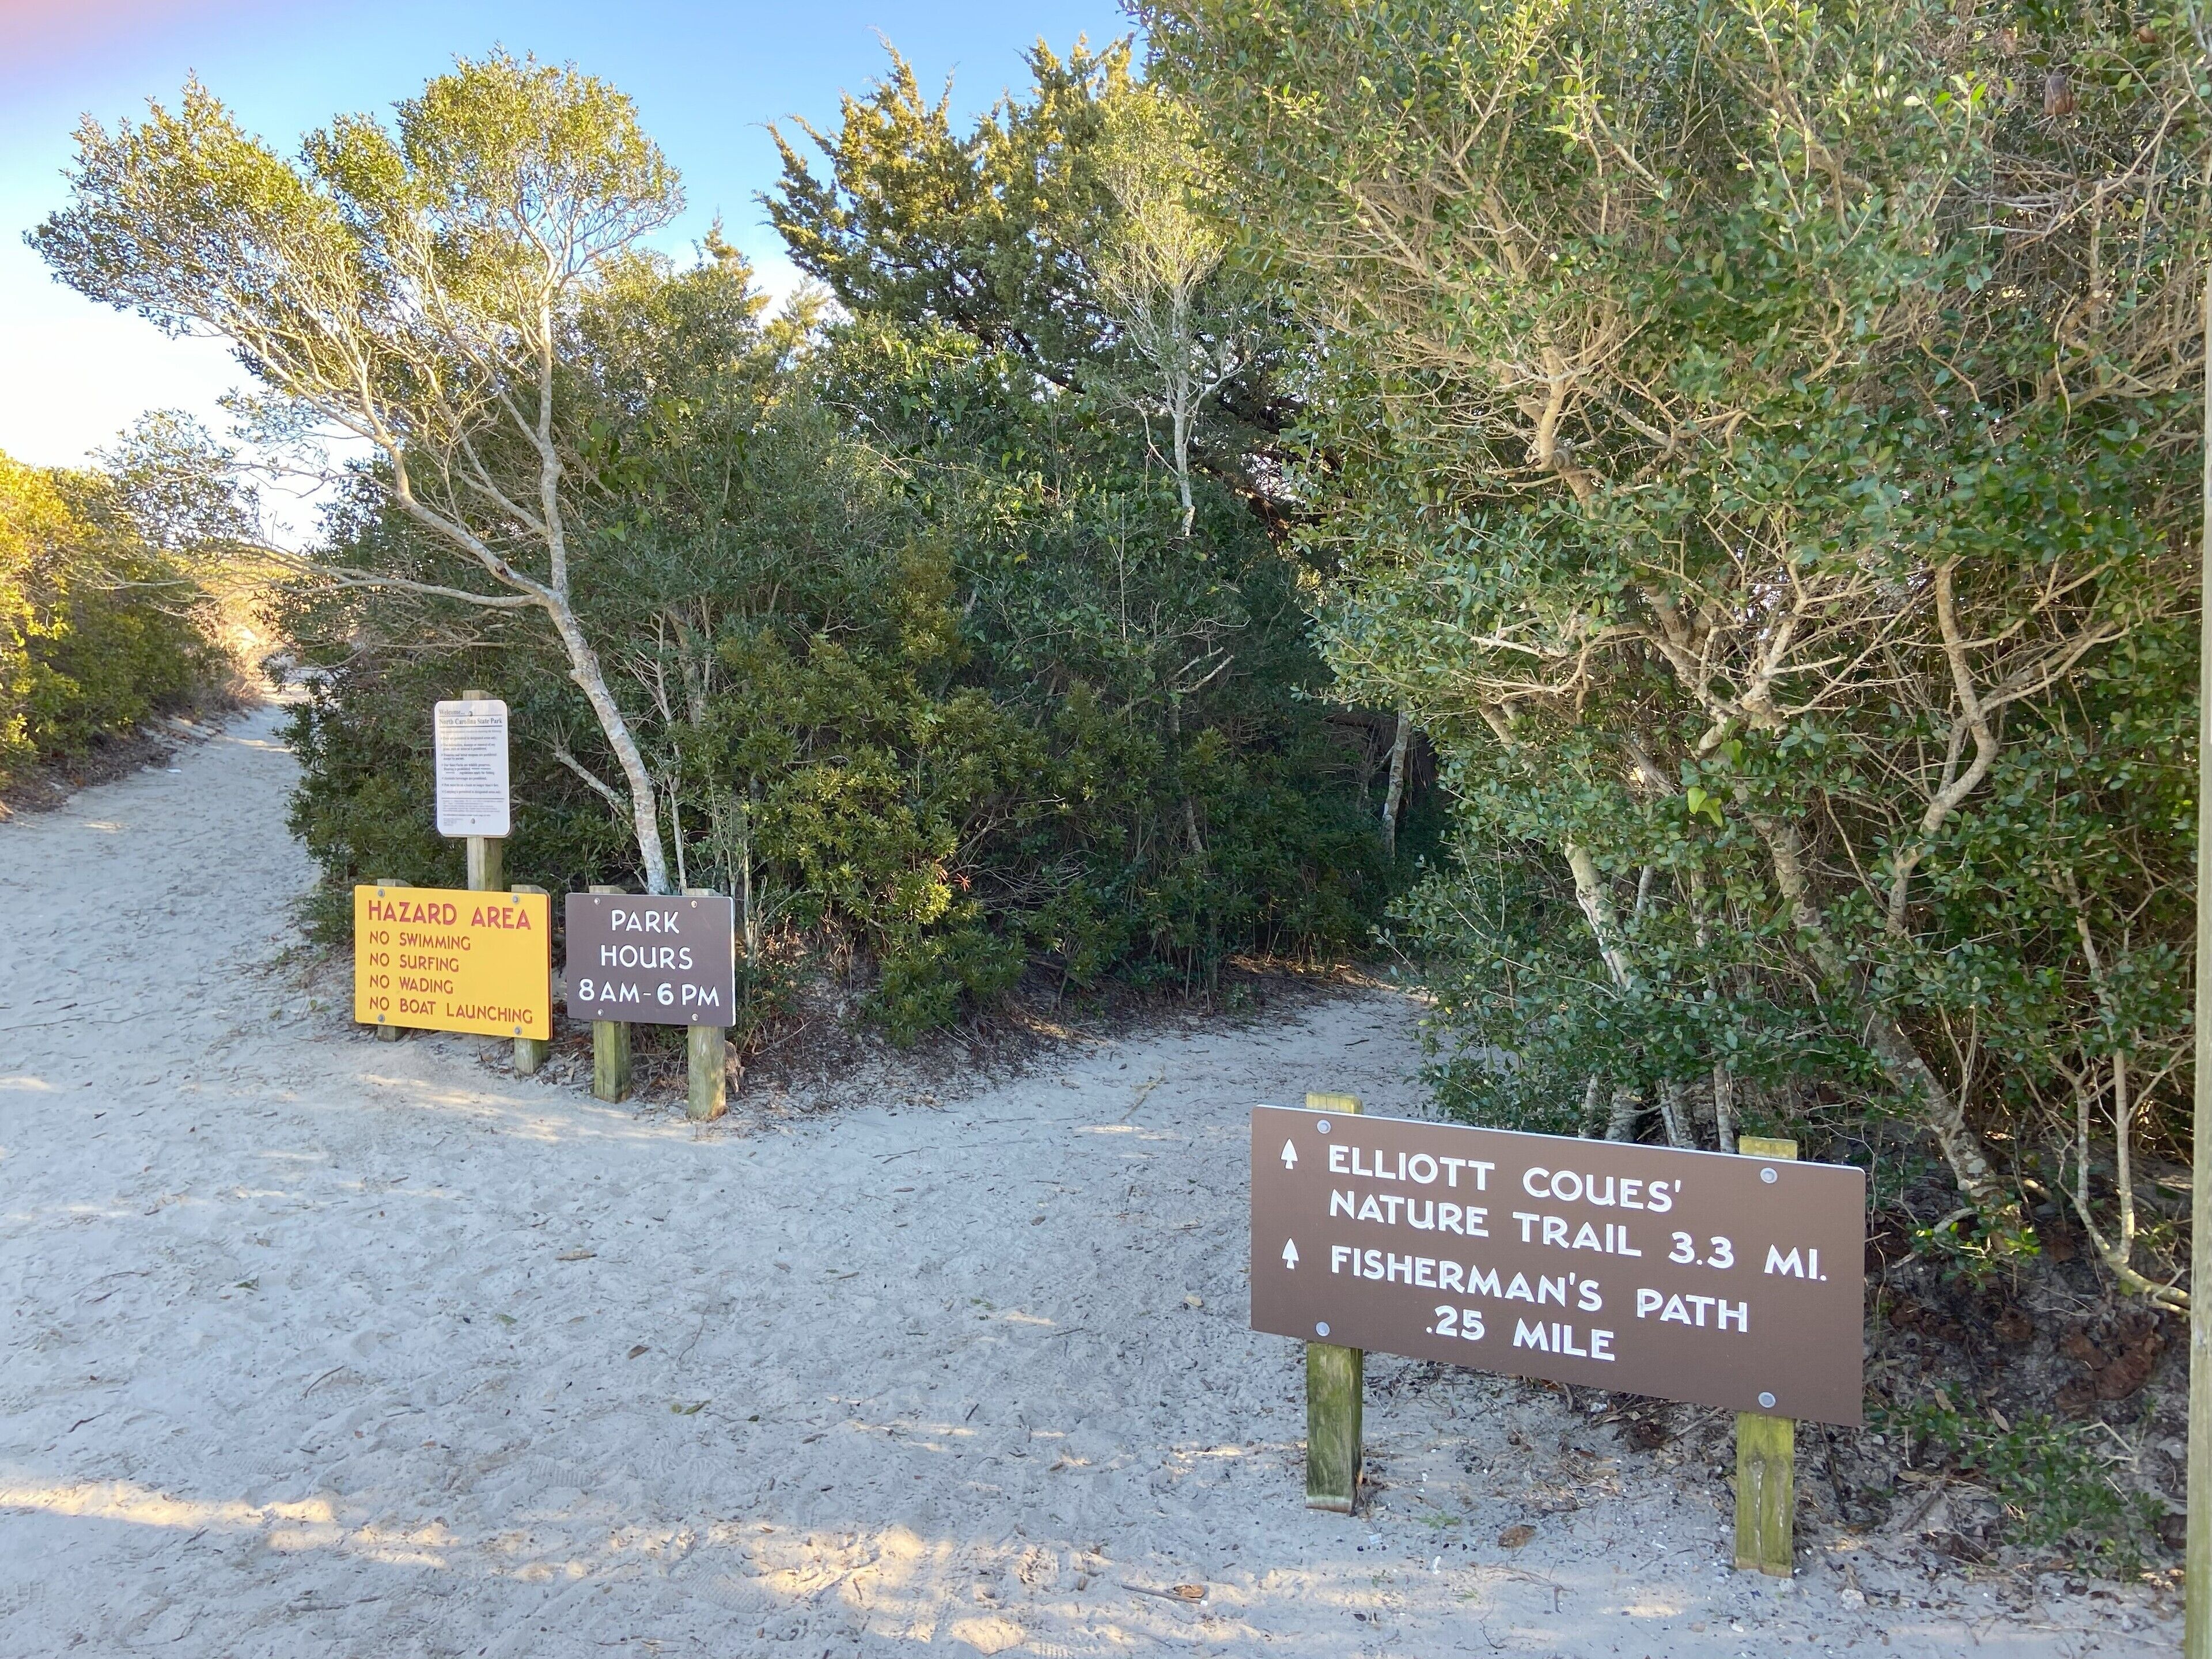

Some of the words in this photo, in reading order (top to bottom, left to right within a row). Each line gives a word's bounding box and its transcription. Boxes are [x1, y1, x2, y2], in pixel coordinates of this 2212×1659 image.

[369, 900, 457, 925] HAZARD
[471, 906, 531, 930] AREA
[612, 909, 680, 934] PARK
[370, 931, 389, 945] NO
[400, 932, 471, 950] SWIMMING
[370, 953, 389, 967] NO
[400, 955, 459, 972] SURFING
[601, 945, 693, 969] HOURS
[370, 975, 389, 989] NO
[399, 976, 453, 994] WADING
[370, 997, 389, 1011] NO
[400, 998, 436, 1015] BOAT
[447, 1003, 533, 1024] LAUNCHING
[1329, 1145, 1495, 1191] ELLIOTT
[1521, 1166, 1681, 1213] COUES'
[1330, 1188, 1489, 1237] NATURE
[1513, 1211, 1642, 1257] TRAIL
[1668, 1232, 1734, 1268] 3.3
[1764, 1244, 1827, 1281] MI.
[1332, 1245, 1603, 1312] FISHERMAN'S
[1637, 1288, 1748, 1333] PATH
[1426, 1305, 1485, 1340] .25
[1513, 1318, 1615, 1361] MILE
